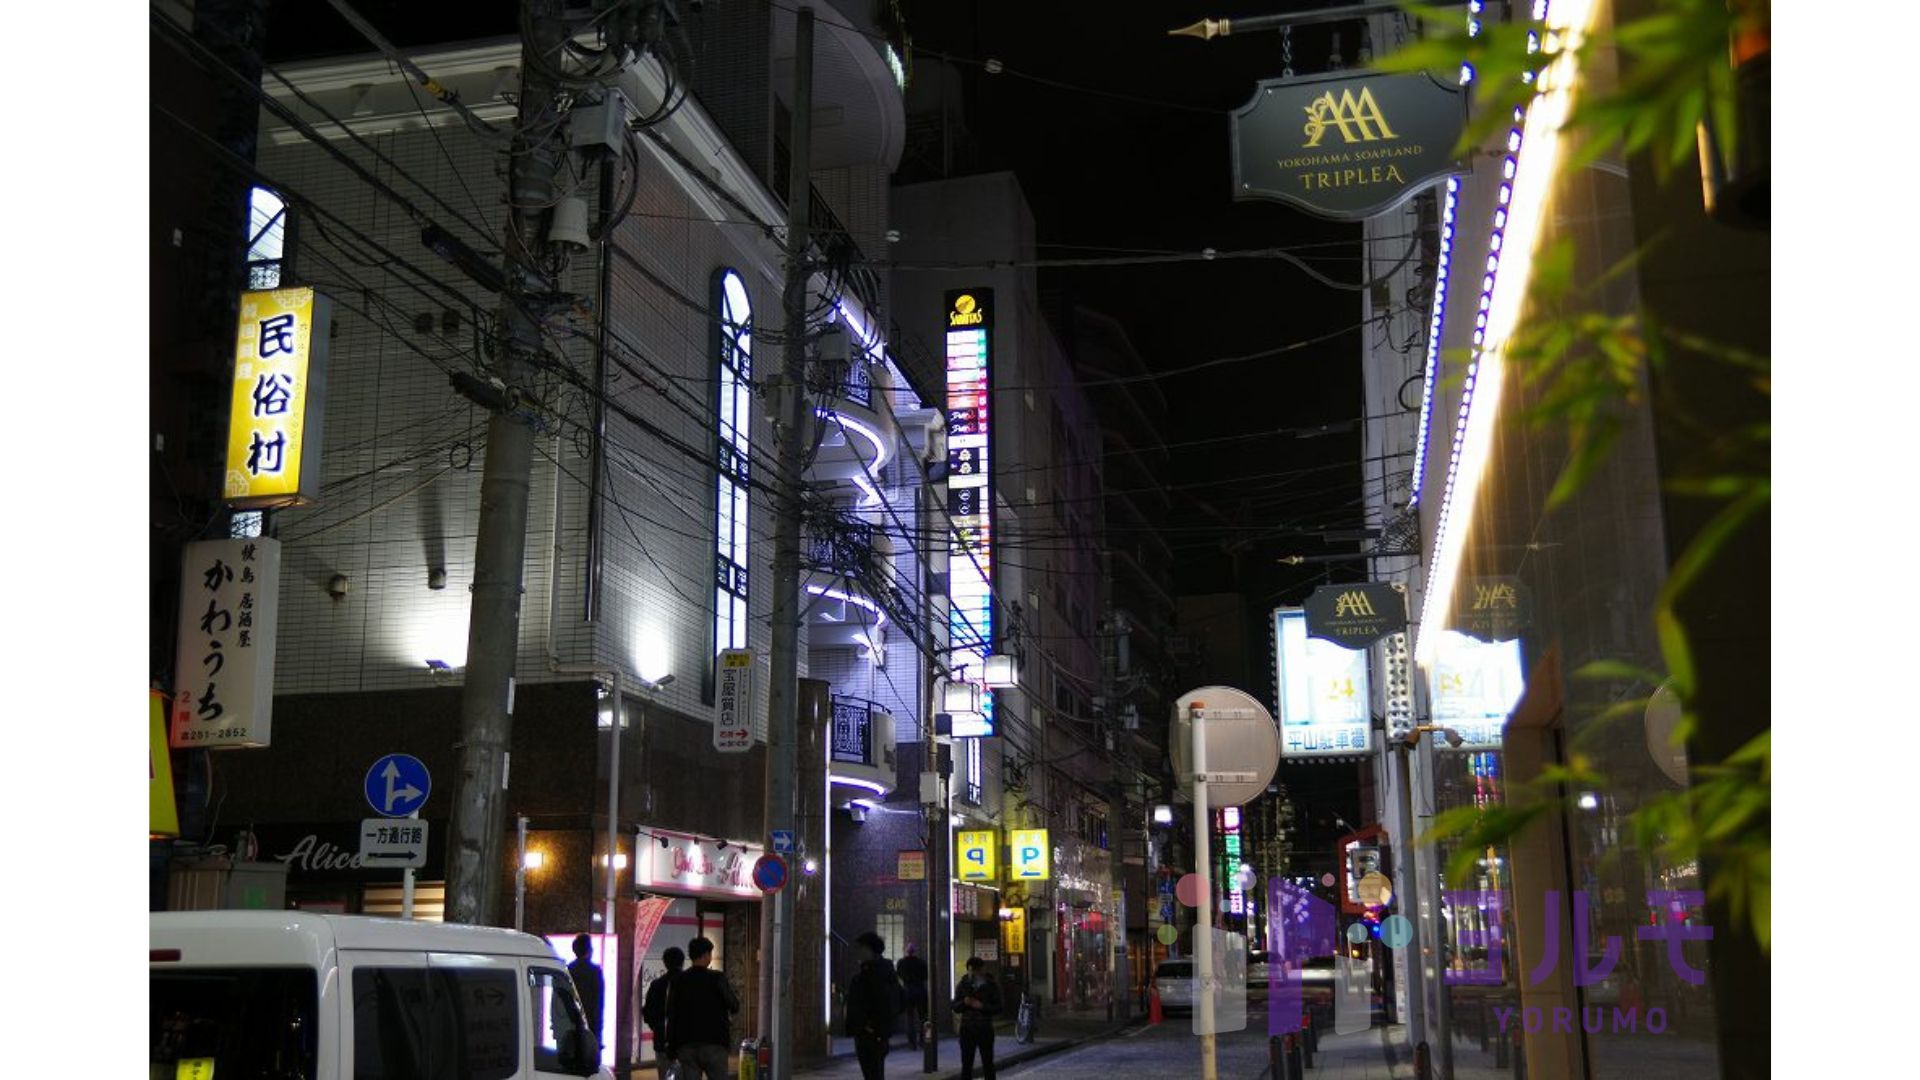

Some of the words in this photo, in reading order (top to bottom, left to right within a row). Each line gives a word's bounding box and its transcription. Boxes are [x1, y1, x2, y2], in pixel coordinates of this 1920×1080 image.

[1277, 153, 1350, 169] YOKOHAMA
[1355, 145, 1423, 161] SOAPLAND
[1300, 164, 1405, 190] TRIPLEA
[246, 313, 297, 476] 民俗村
[237, 593, 254, 648] 居酒屋
[198, 558, 234, 721] かわうち
[365, 826, 422, 846] 一方通行路
[1021, 846, 1040, 865] P
